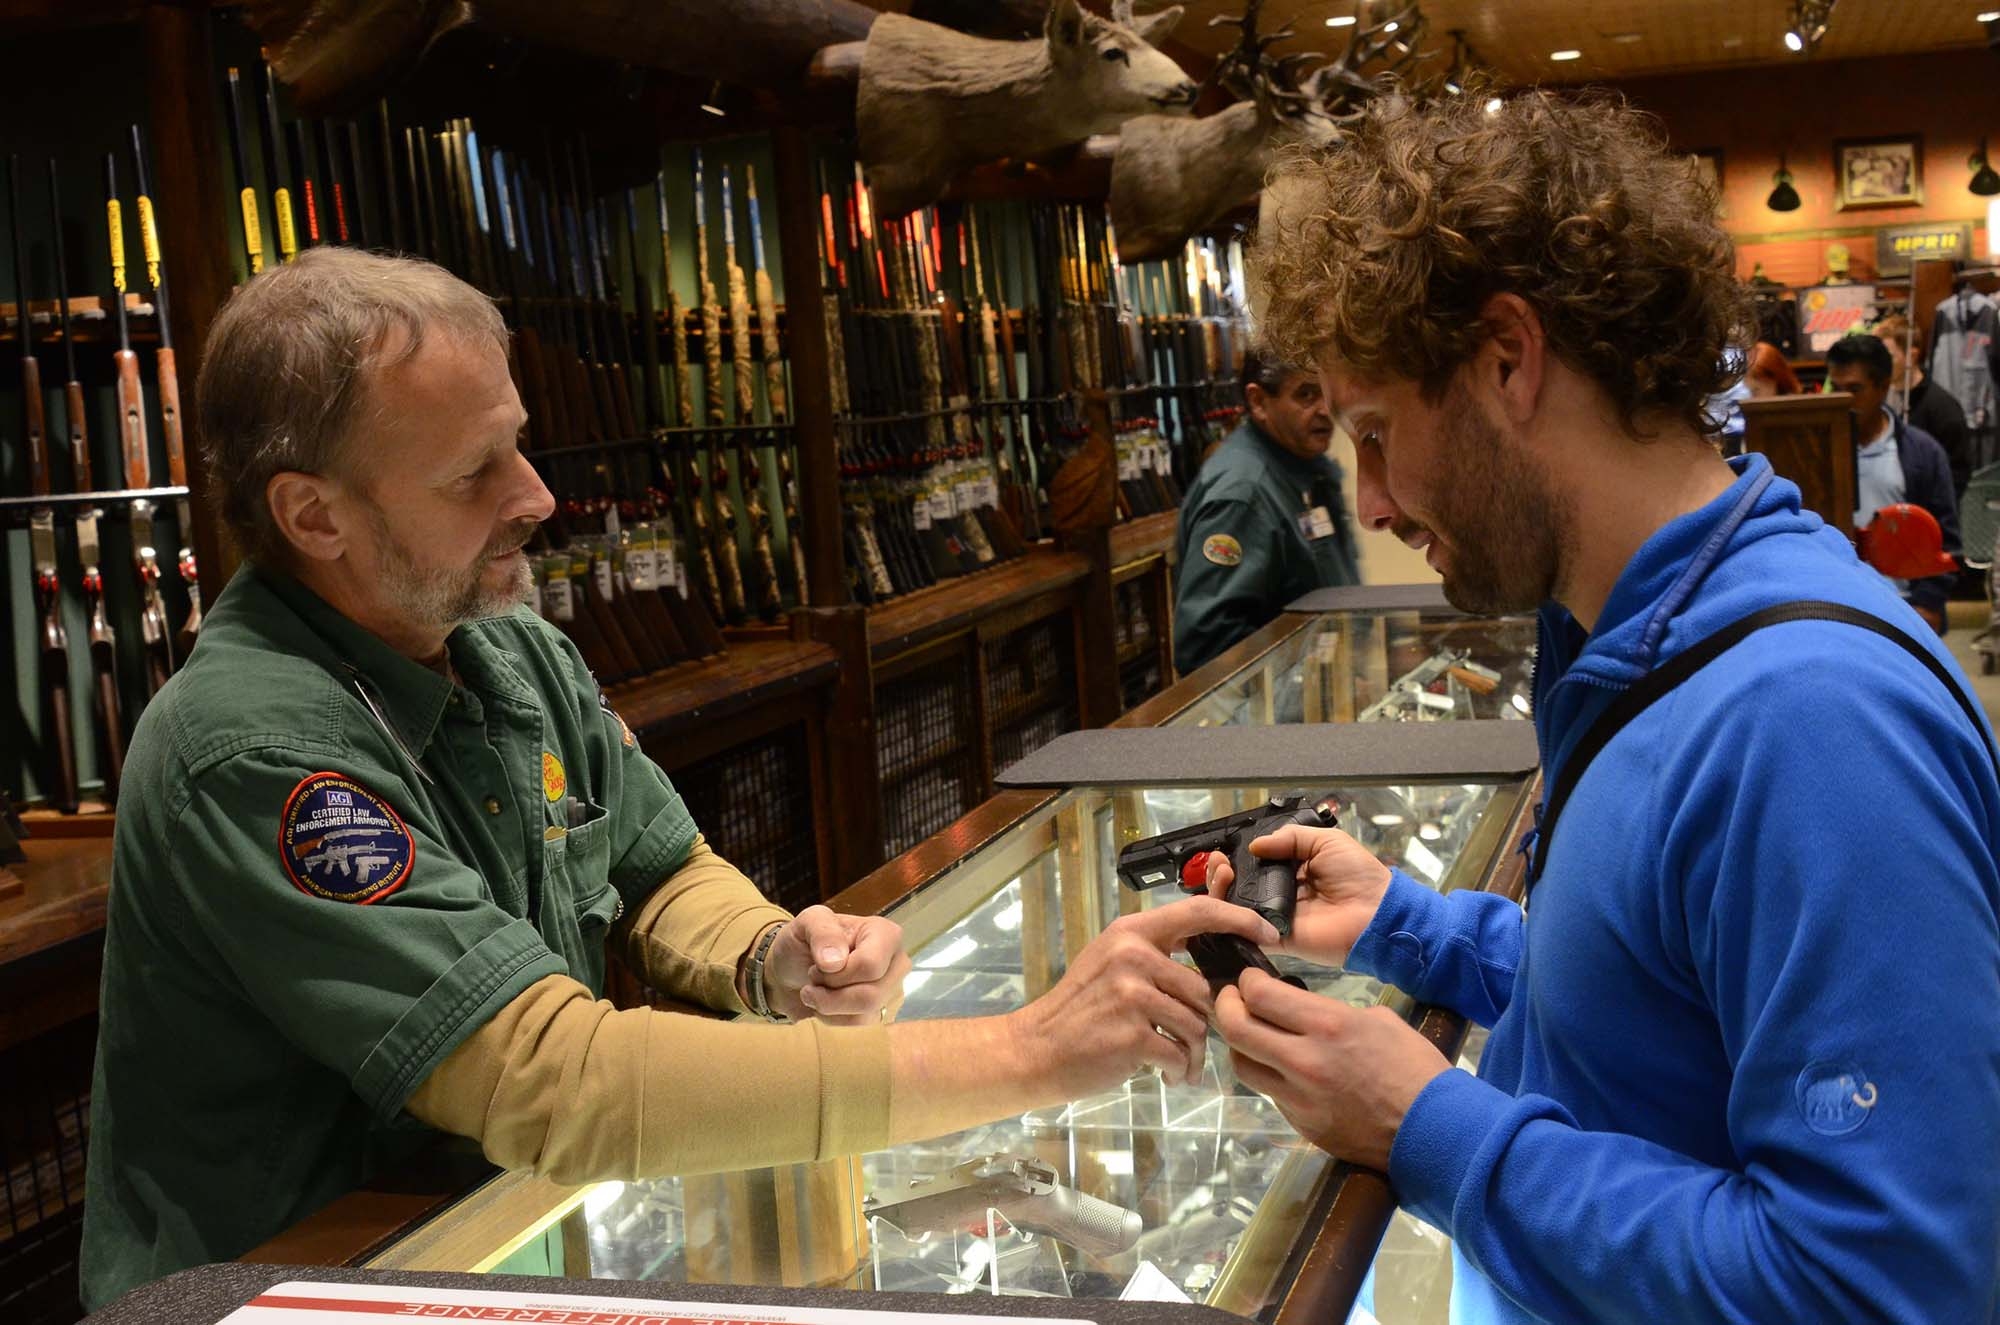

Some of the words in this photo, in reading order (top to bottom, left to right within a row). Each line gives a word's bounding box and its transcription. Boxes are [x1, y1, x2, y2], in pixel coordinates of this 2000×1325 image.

[309, 781, 325, 793] LAW
[325, 780, 377, 804] ENFORCEMENT
[329, 793, 350, 804] AGI
[311, 807, 351, 820] CERTIFIED
[352, 808, 370, 818] LAW
[295, 816, 352, 833] ENFORCEMENT
[353, 816, 390, 828] ARMORER
[377, 860, 403, 888] INSTITUTE
[395, 1303, 671, 1325] DIFFERENCE
